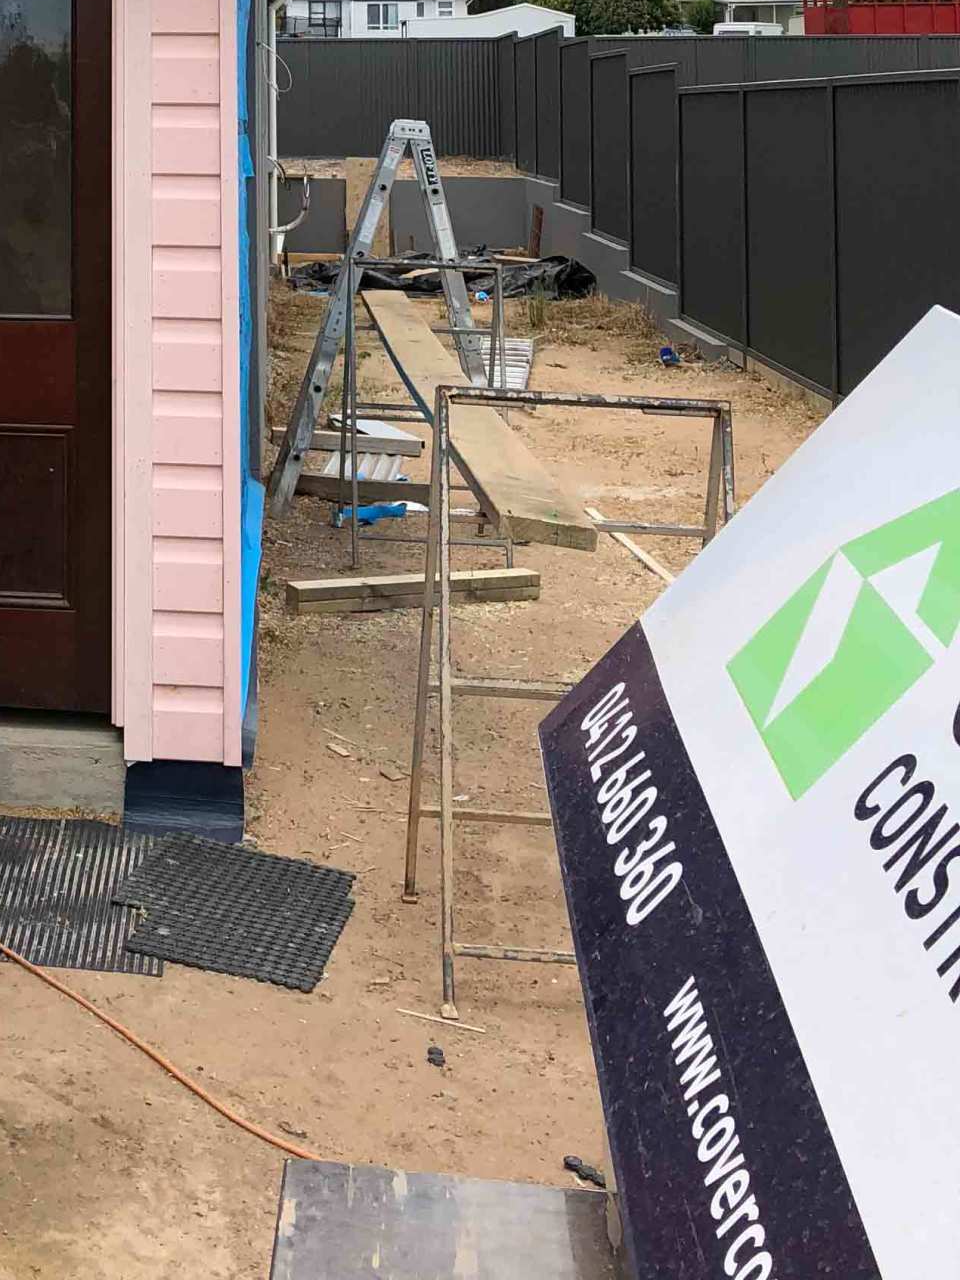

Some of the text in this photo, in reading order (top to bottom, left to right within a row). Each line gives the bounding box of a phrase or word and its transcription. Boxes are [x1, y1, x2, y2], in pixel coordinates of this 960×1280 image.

[422, 149, 438, 184] LOFTY
[581, 682, 637, 783] 0412
[597, 751, 657, 845] 660
[614, 815, 683, 925] 360
